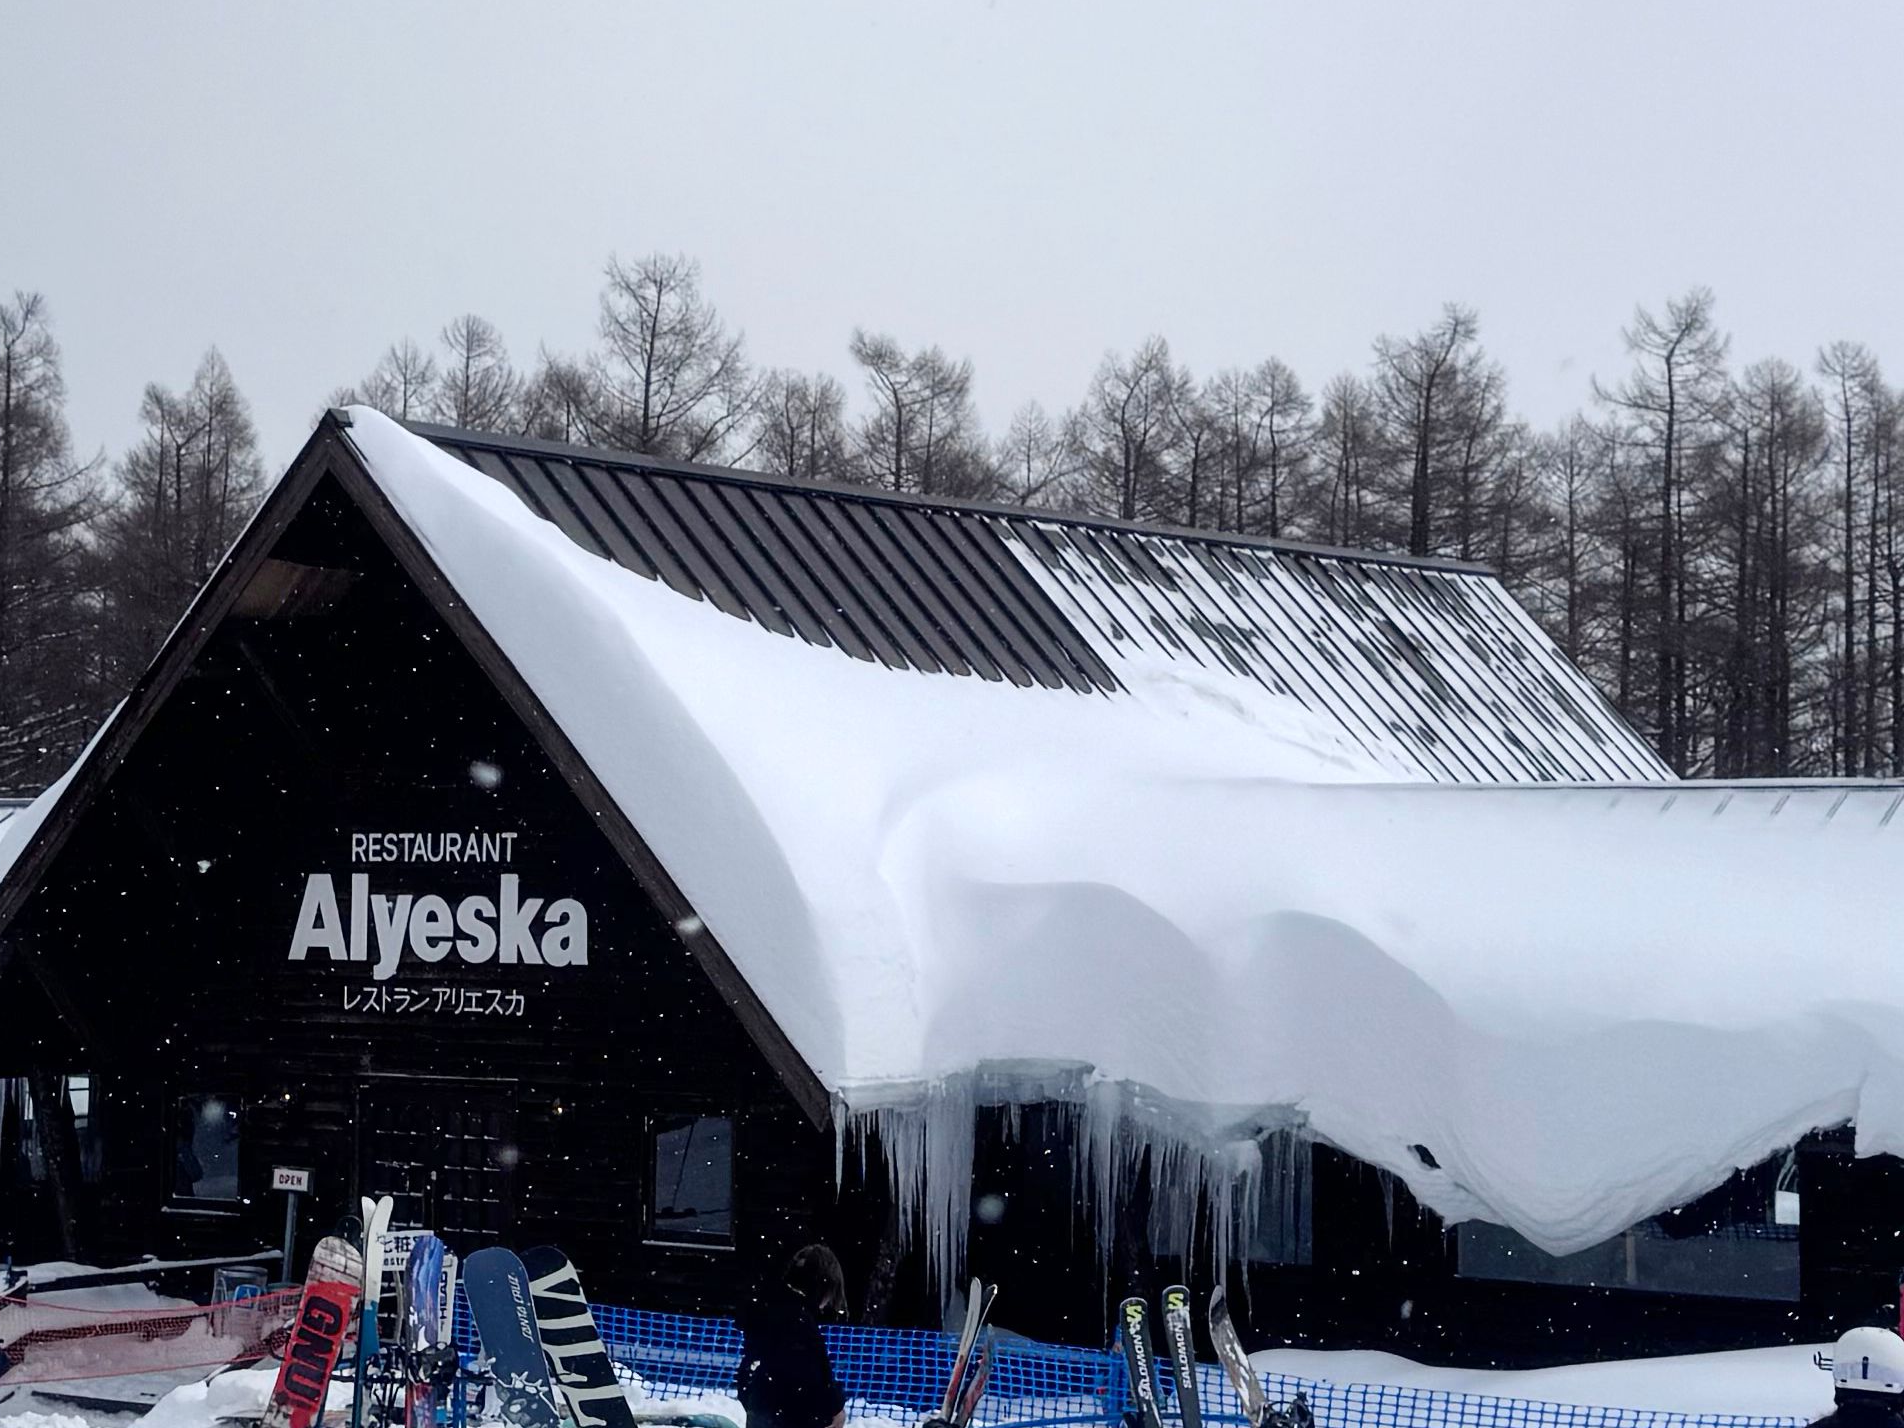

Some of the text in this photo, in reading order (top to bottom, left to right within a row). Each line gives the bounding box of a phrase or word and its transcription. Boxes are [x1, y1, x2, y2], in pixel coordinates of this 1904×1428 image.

[351, 832, 518, 863] RESTAURANT
[288, 873, 589, 981] Alyeska
[278, 1173, 303, 1187] OPEN
[1174, 1322, 1193, 1389] SALOMON
